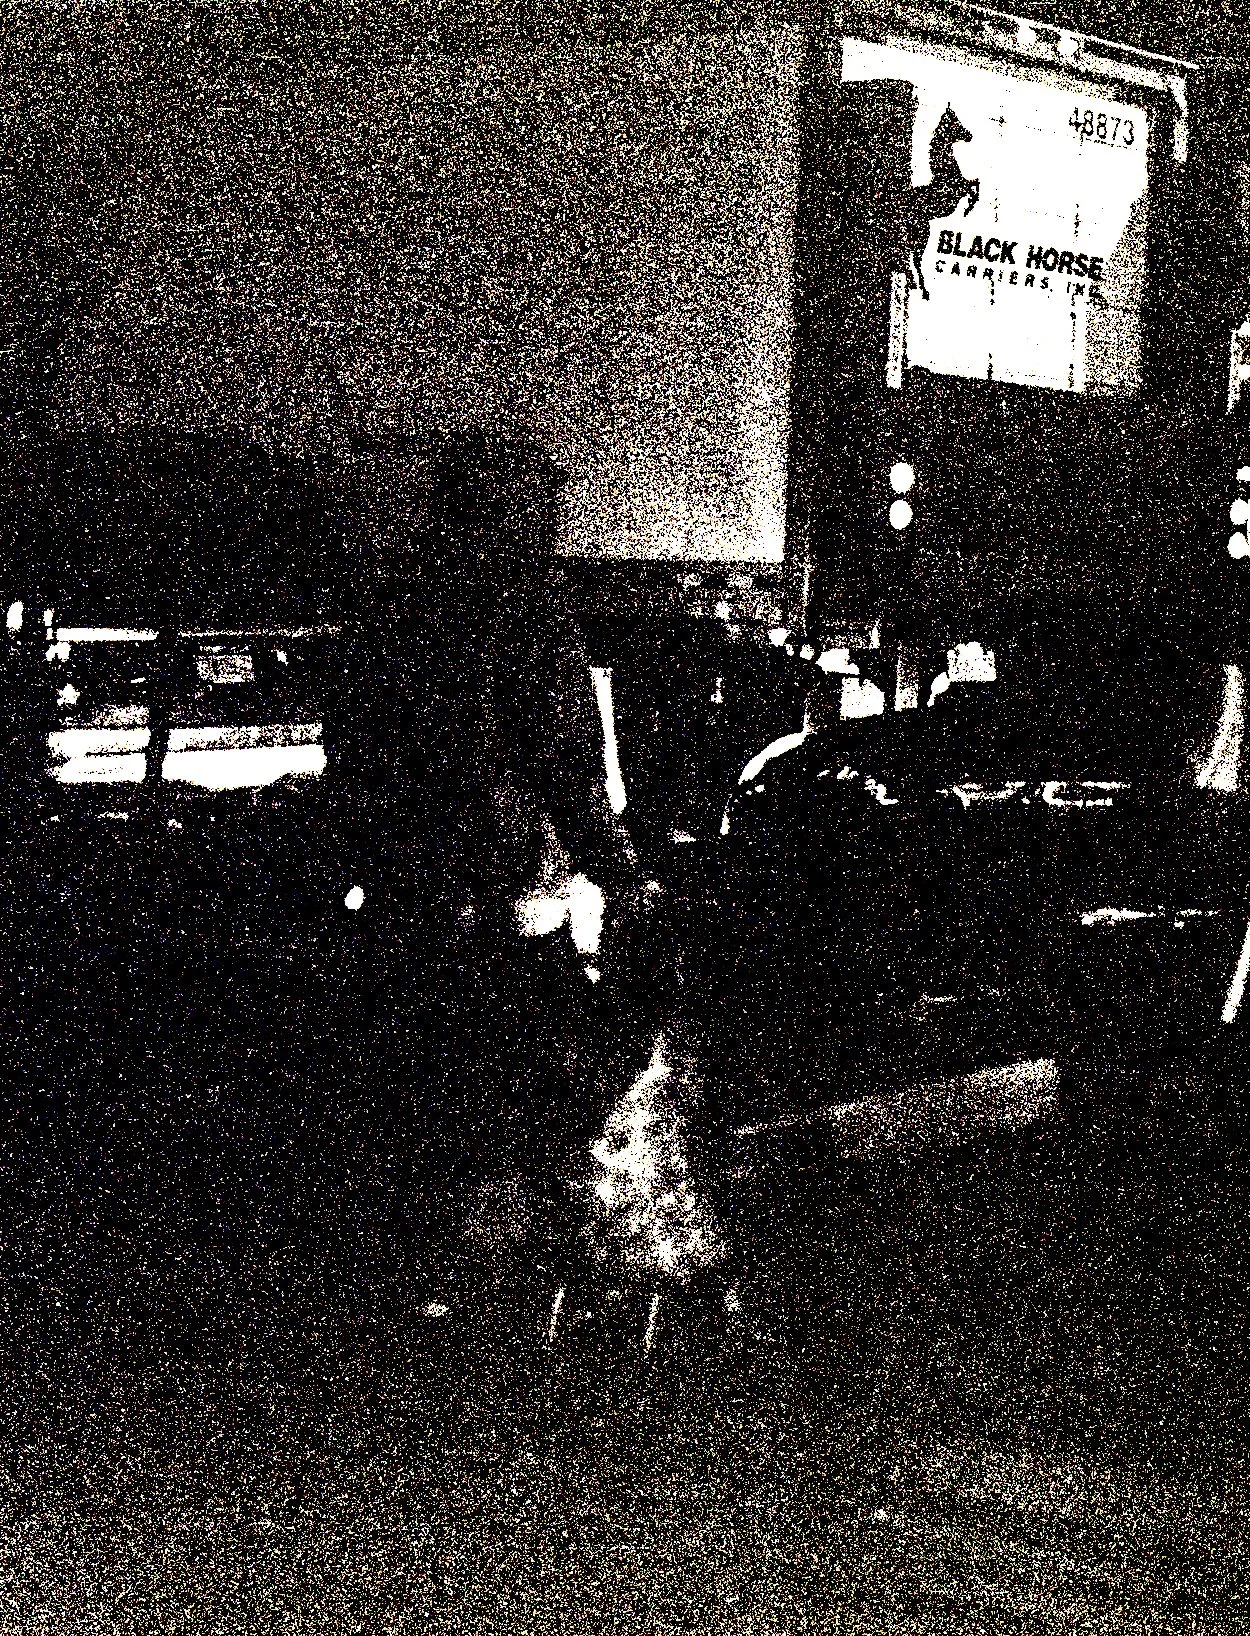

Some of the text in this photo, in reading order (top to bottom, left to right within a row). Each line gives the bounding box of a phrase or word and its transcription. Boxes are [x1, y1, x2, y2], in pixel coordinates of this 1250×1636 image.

[1068, 106, 1135, 146] 48873
[936, 229, 1105, 281] BLACK HORSE
